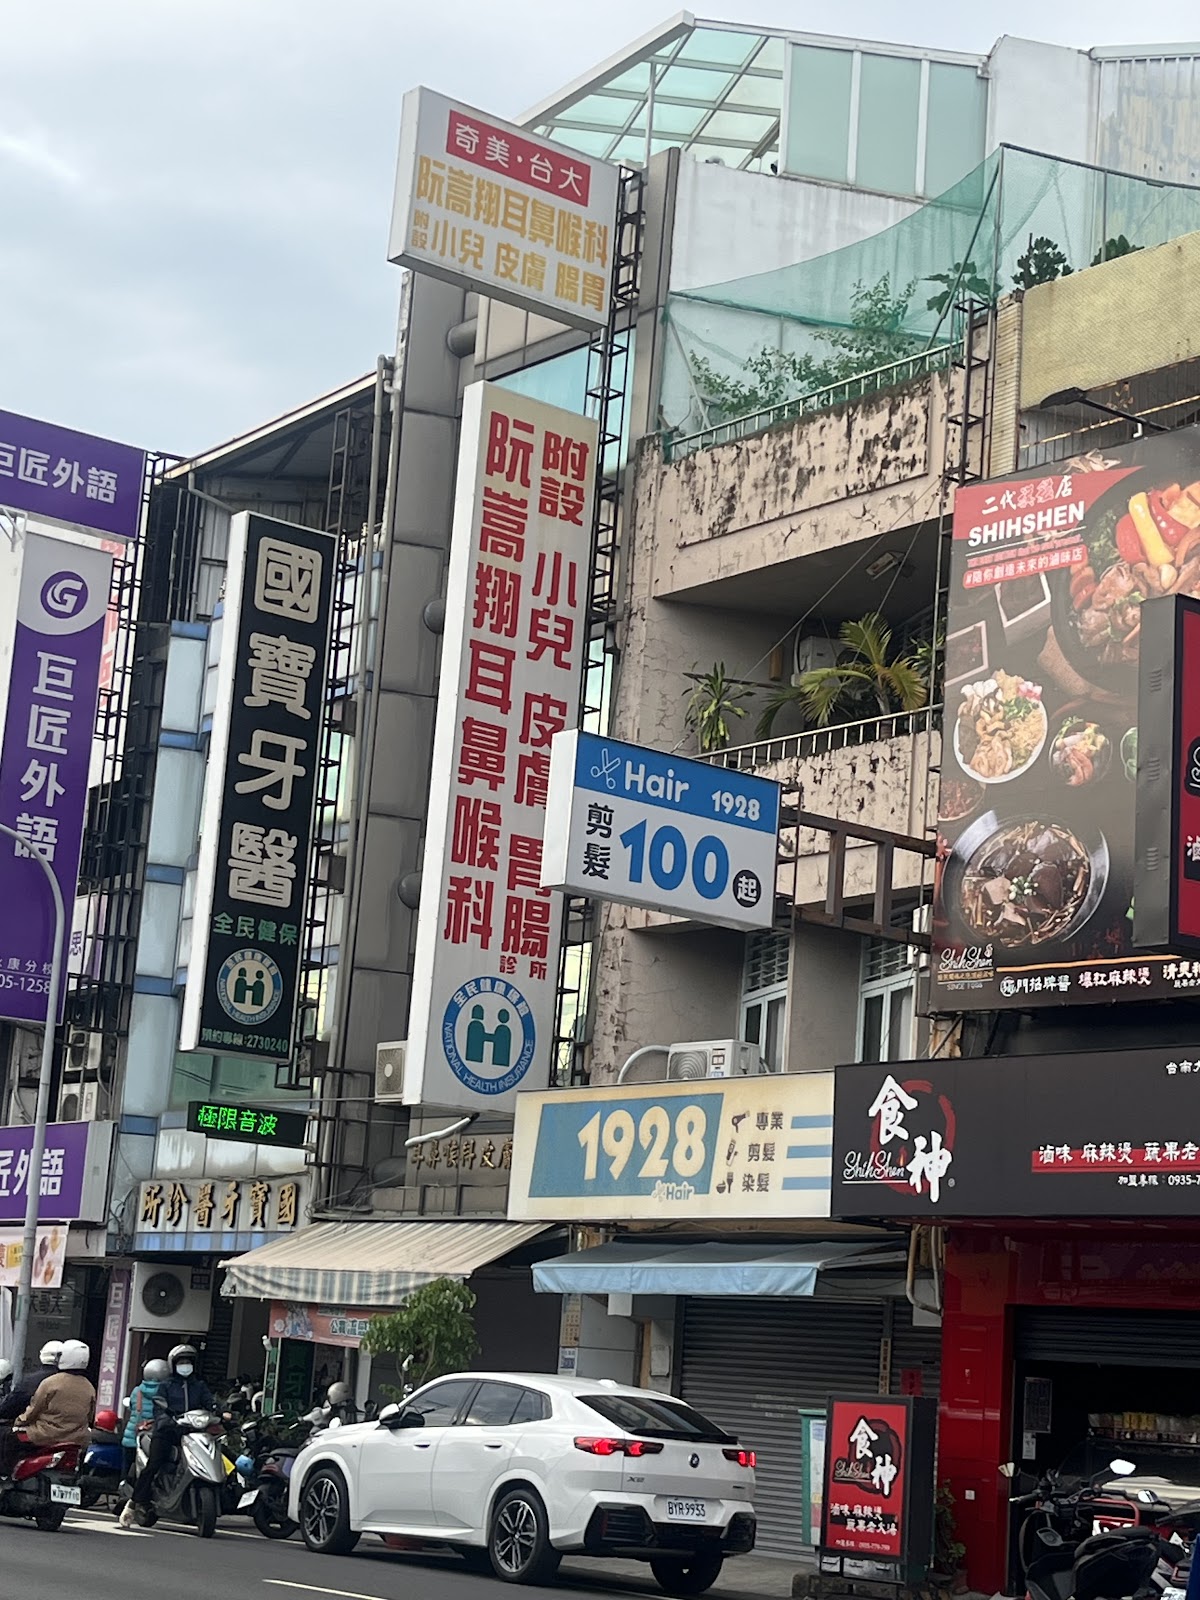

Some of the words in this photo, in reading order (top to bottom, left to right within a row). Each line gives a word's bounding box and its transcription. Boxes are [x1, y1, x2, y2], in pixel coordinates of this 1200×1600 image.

[416, 155, 608, 269] 阮嵩翔耳鼻喉科
[431, 219, 486, 271] 小兒
[538, 430, 589, 526] 附設
[967, 500, 1085, 547] SHIHSHEN
[526, 551, 577, 671] 小兒
[444, 411, 535, 951] 阮嵩翔耳鼻喉科
[14, 651, 77, 862] 巨匠外語
[227, 536, 323, 909] 國寶牙醫
[624, 760, 689, 803] Hair
[711, 789, 761, 821] 1928
[582, 802, 615, 880] 剪髮
[619, 818, 729, 900] 100
[213, 911, 298, 946] 全民健保
[198, 1105, 278, 1135] 極限音波
[577, 1105, 707, 1180] 1928
[748, 1142, 776, 1163] 剪髮
[756, 1112, 784, 1131] 專業
[742, 1173, 770, 1194] 染髮
